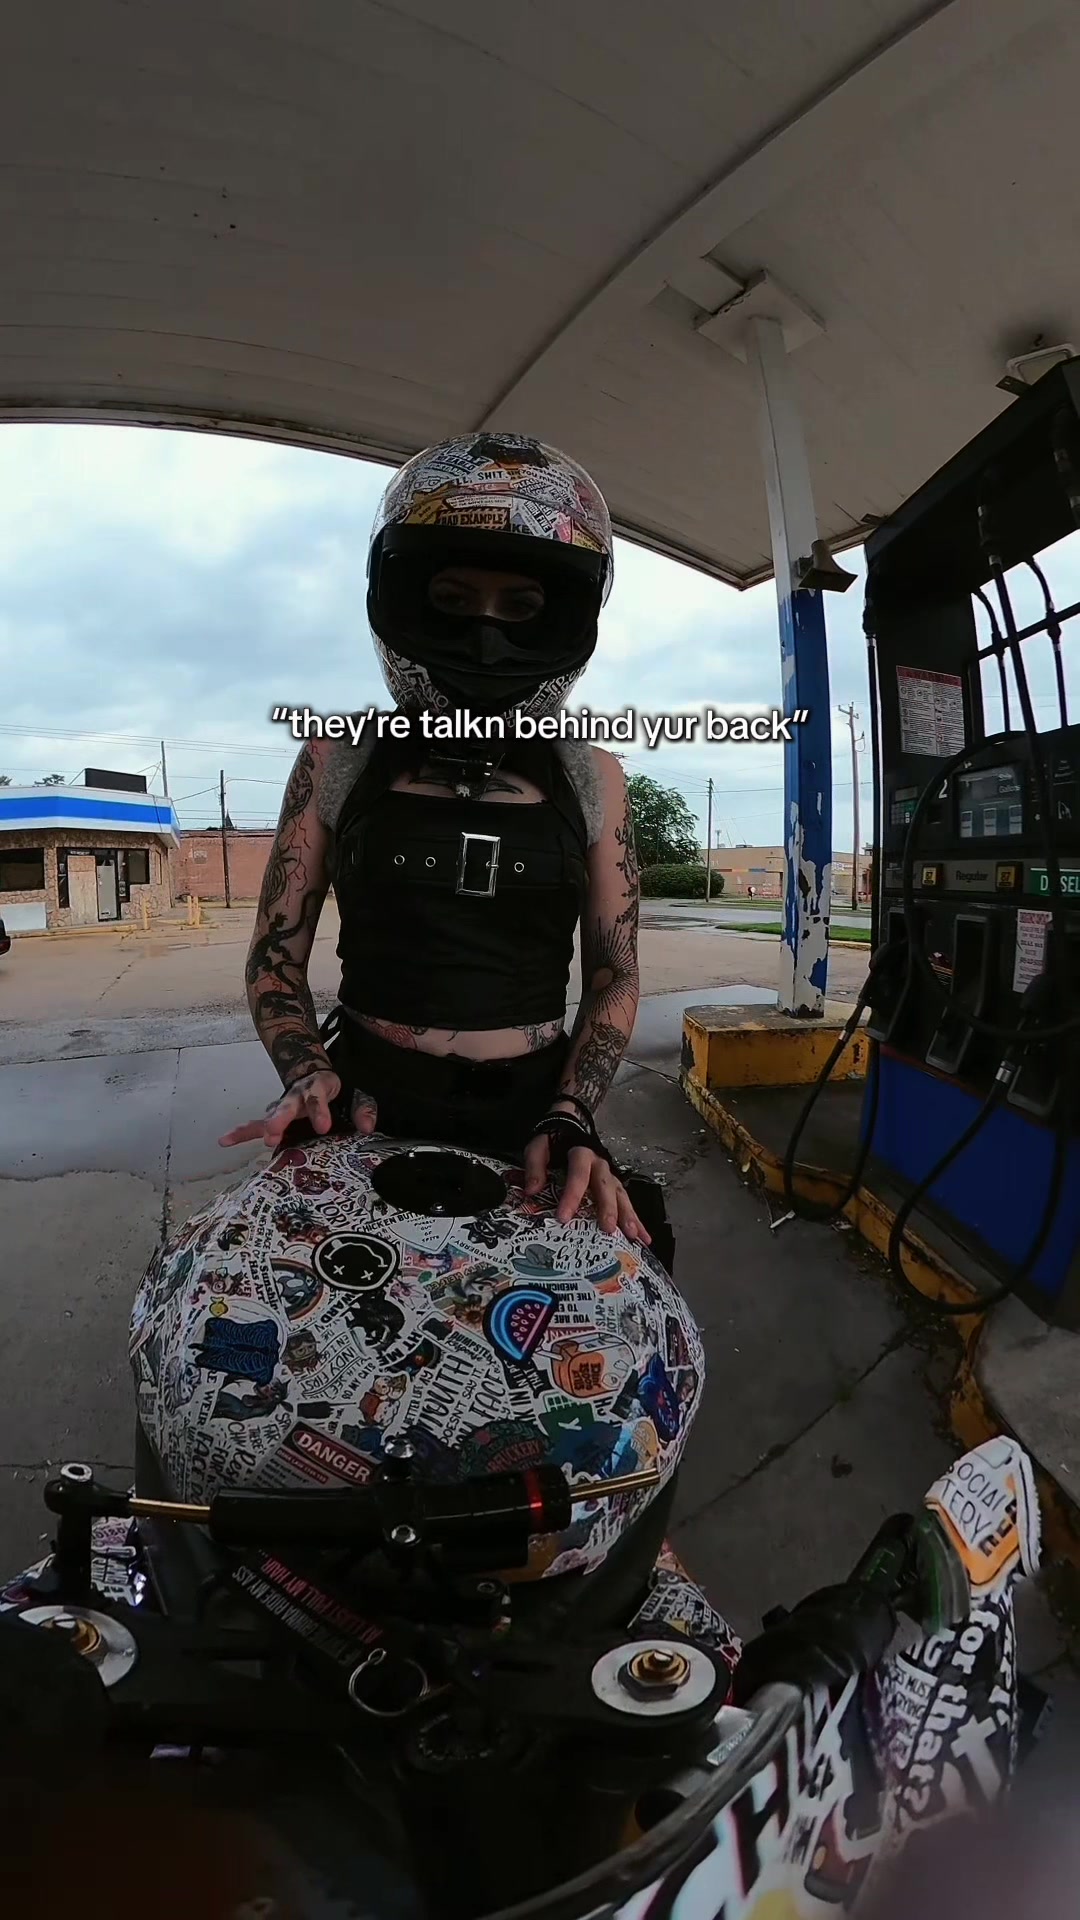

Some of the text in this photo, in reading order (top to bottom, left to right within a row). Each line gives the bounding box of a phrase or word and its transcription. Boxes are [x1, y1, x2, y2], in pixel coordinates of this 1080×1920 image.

[477, 470, 508, 481] SHIT.
[460, 512, 504, 525] EXAMPLE
[938, 778, 949, 799] 2
[1040, 875, 1080, 893] DSEL
[357, 1217, 396, 1233] CHICKEN
[545, 1230, 585, 1246] eyes
[454, 1240, 509, 1265] STRAWBERRY
[557, 1246, 609, 1269] sorry
[576, 1292, 592, 1301] THE
[618, 1275, 640, 1300] LOSER
[554, 1313, 590, 1323] YOU ARE
[567, 1304, 578, 1312] TO
[300, 1371, 330, 1392] FIRST
[348, 1378, 361, 1392] MY
[357, 1362, 376, 1380] CATS
[590, 1362, 601, 1389] JUICE
[198, 1389, 214, 1426] WEIR
[440, 1400, 467, 1445] DOESN'T
[462, 1380, 478, 1400] SAY
[297, 1432, 371, 1483] DANGER
[941, 1478, 992, 1544] TERY
[231, 1565, 257, 1587] ASS
[247, 1578, 271, 1599] MY
[260, 1590, 292, 1615] RIDE
